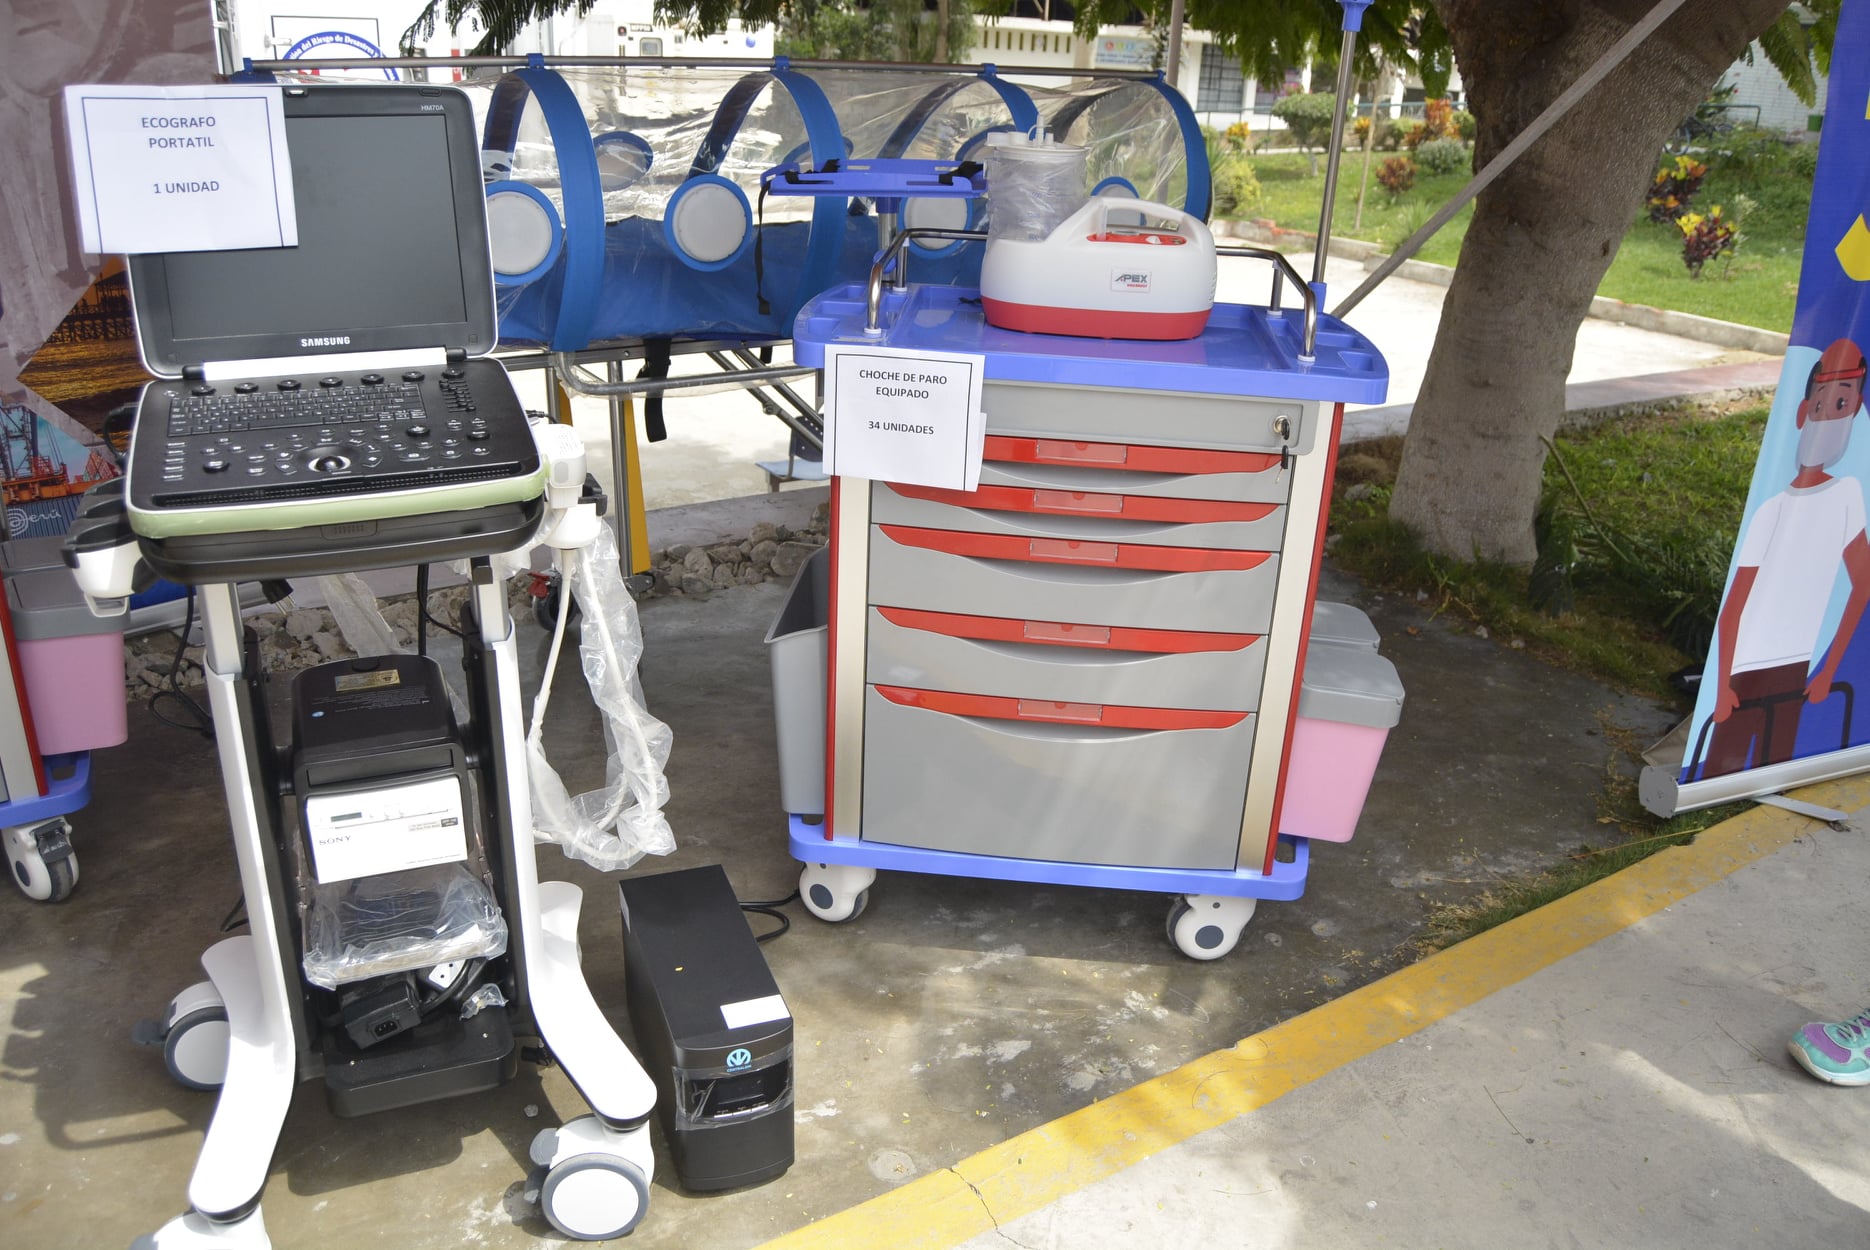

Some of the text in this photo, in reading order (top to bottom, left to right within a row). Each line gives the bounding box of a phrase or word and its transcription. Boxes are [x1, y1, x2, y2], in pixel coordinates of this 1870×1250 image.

[311, 34, 334, 45] Riesgo
[334, 34, 343, 42] de
[344, 34, 375, 57] Desastres
[141, 116, 216, 128] ECOGRAFO
[148, 136, 215, 149] PORTATIL
[153, 181, 220, 194] 1 UNIDAD
[1114, 273, 1148, 283] APEX
[300, 336, 350, 347] SAMSUNG
[859, 369, 948, 385] CHOCHE DE PARO
[876, 386, 929, 399] EQUIPADO
[868, 420, 935, 435] 34 UNIDADES
[319, 835, 351, 846] SONY
